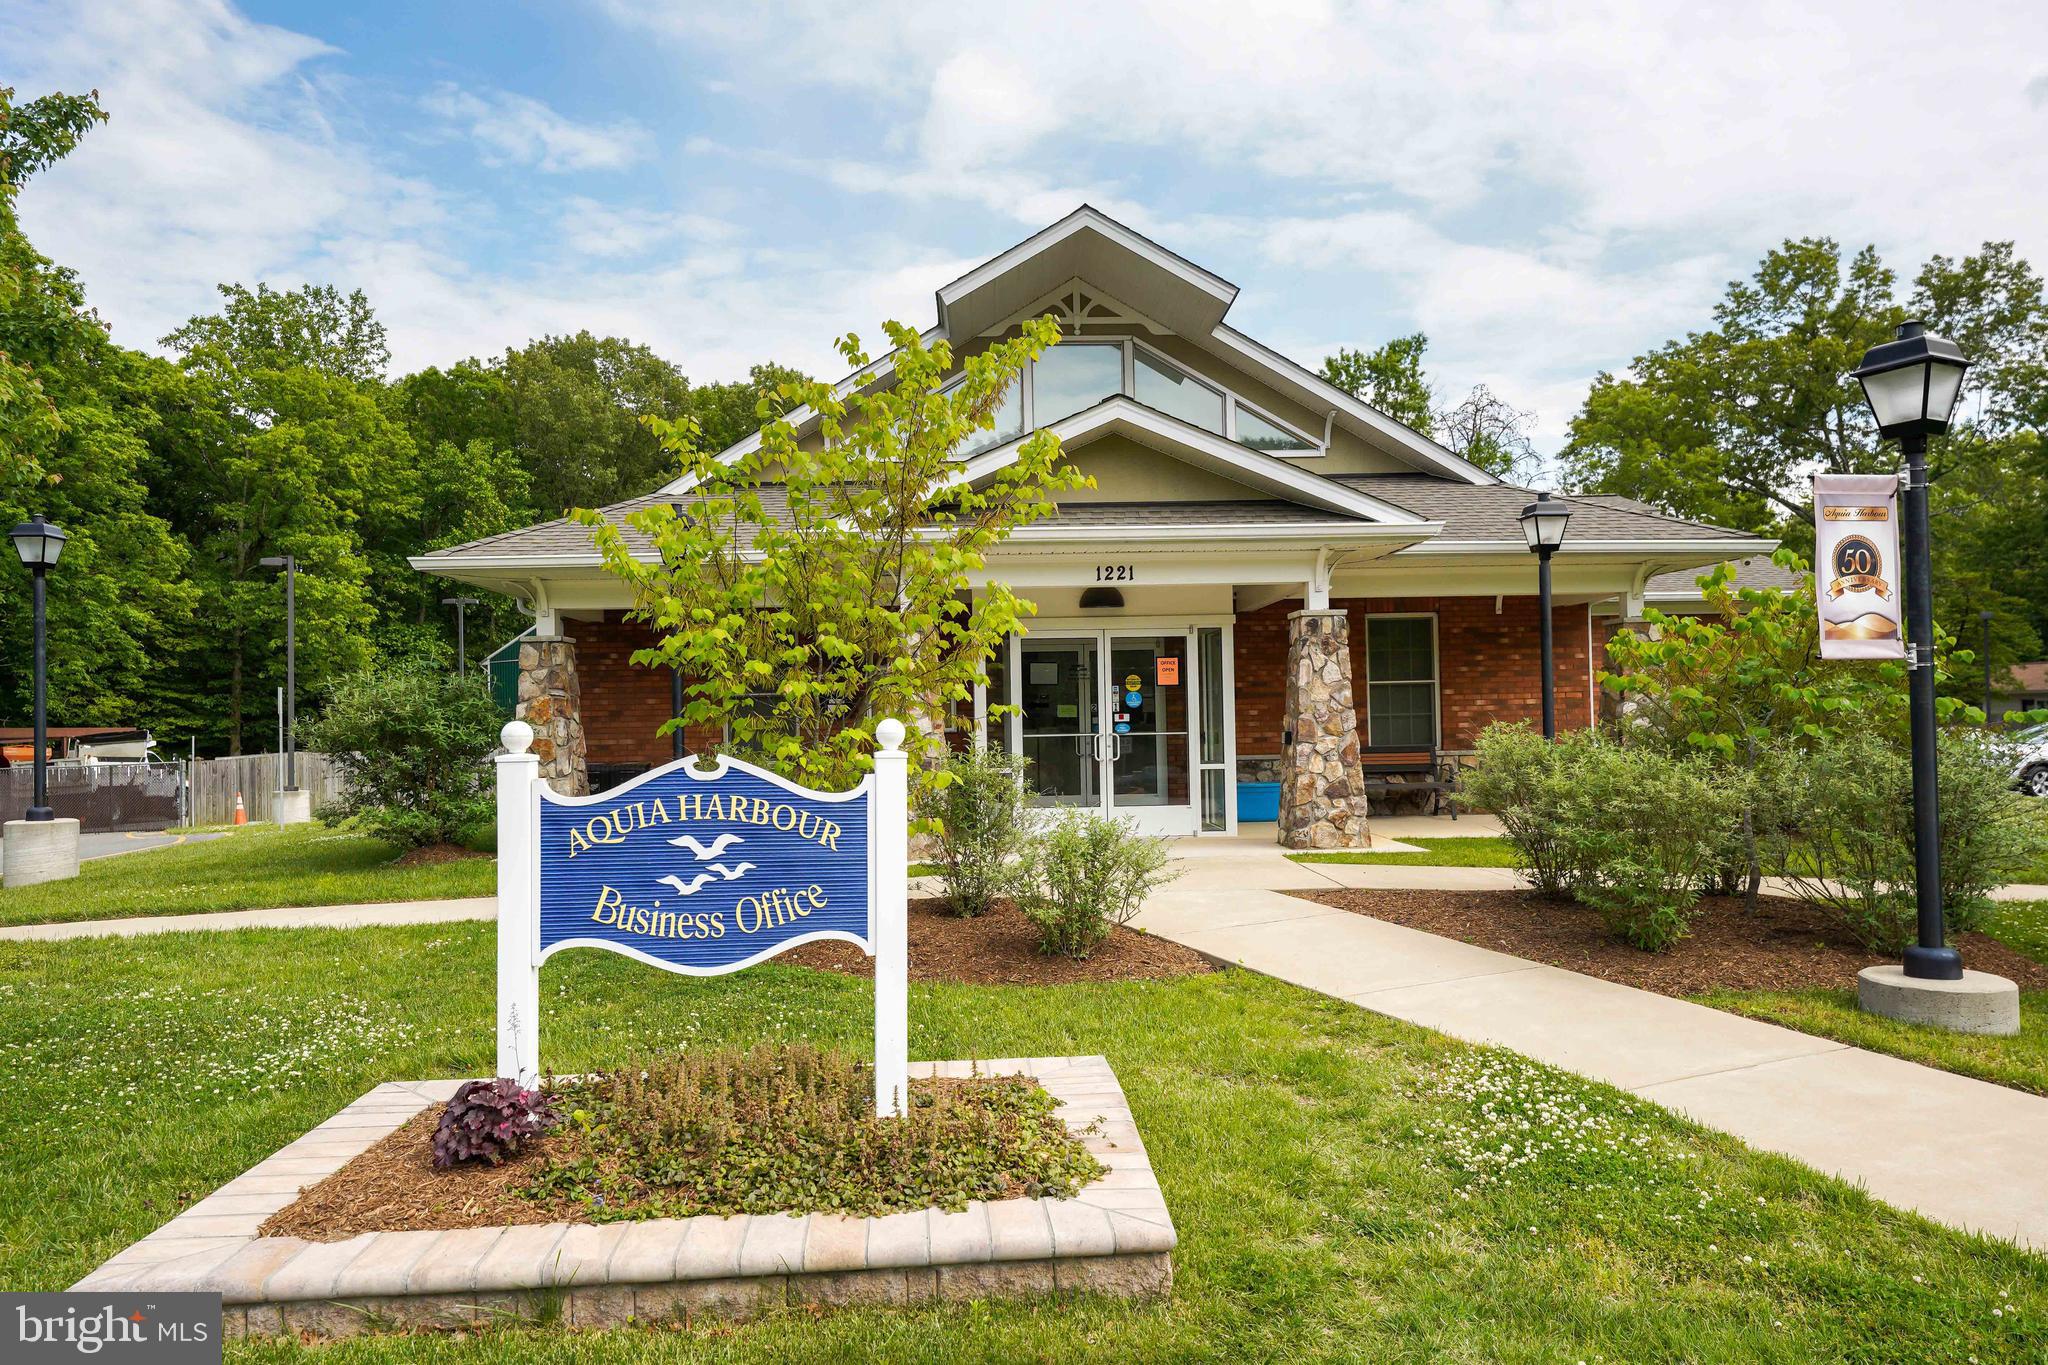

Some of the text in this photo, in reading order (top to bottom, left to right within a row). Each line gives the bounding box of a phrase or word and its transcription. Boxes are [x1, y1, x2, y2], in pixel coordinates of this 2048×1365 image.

[1825, 509, 1851, 519] Aquia
[1096, 565, 1134, 581] 1221
[1841, 549, 1871, 574] 50
[568, 793, 842, 858] AQUIA HARBOUR
[591, 884, 828, 940] Business Office
